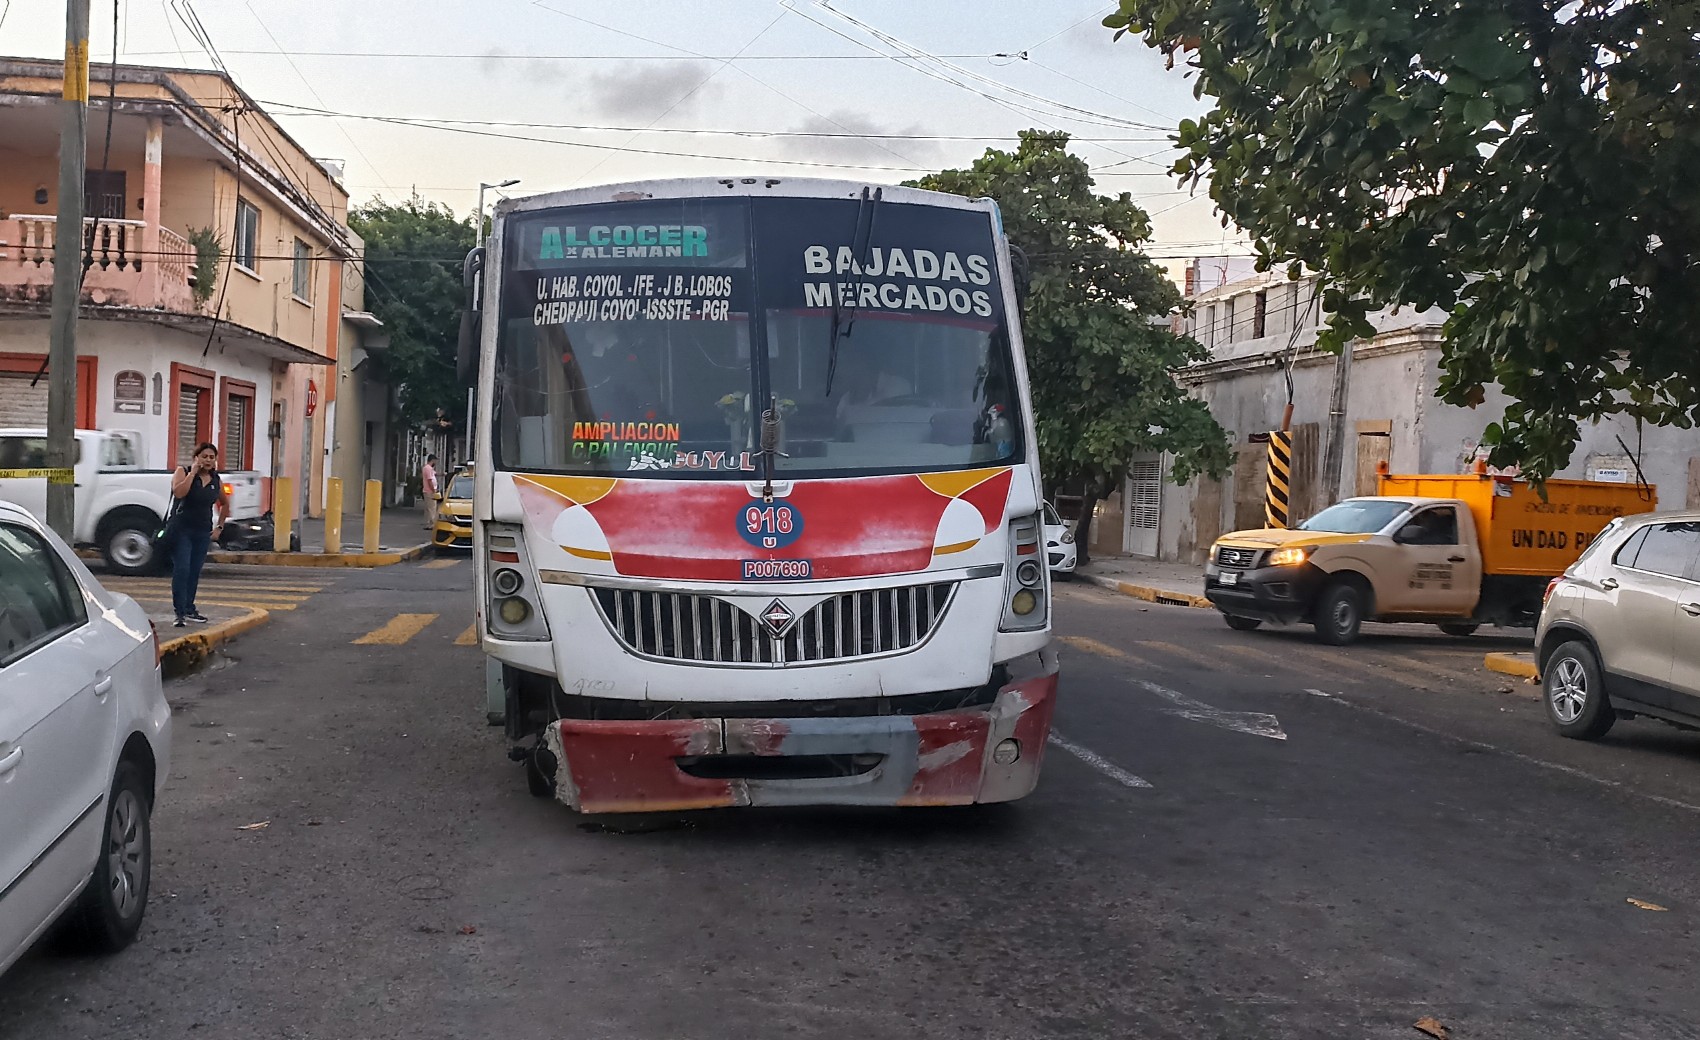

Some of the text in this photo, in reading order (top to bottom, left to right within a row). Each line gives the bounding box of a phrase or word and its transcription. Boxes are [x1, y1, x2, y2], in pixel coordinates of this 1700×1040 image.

[539, 225, 708, 259] ALCOCER
[581, 246, 681, 258] ALEMAN
[804, 245, 991, 286] BAJADAS
[583, 275, 623, 297] COYOL
[804, 282, 992, 317] MERCADOS
[572, 421, 680, 442] AMPLIACION
[746, 506, 793, 534] 918
[763, 536, 777, 548] U
[744, 560, 809, 578] P007690
